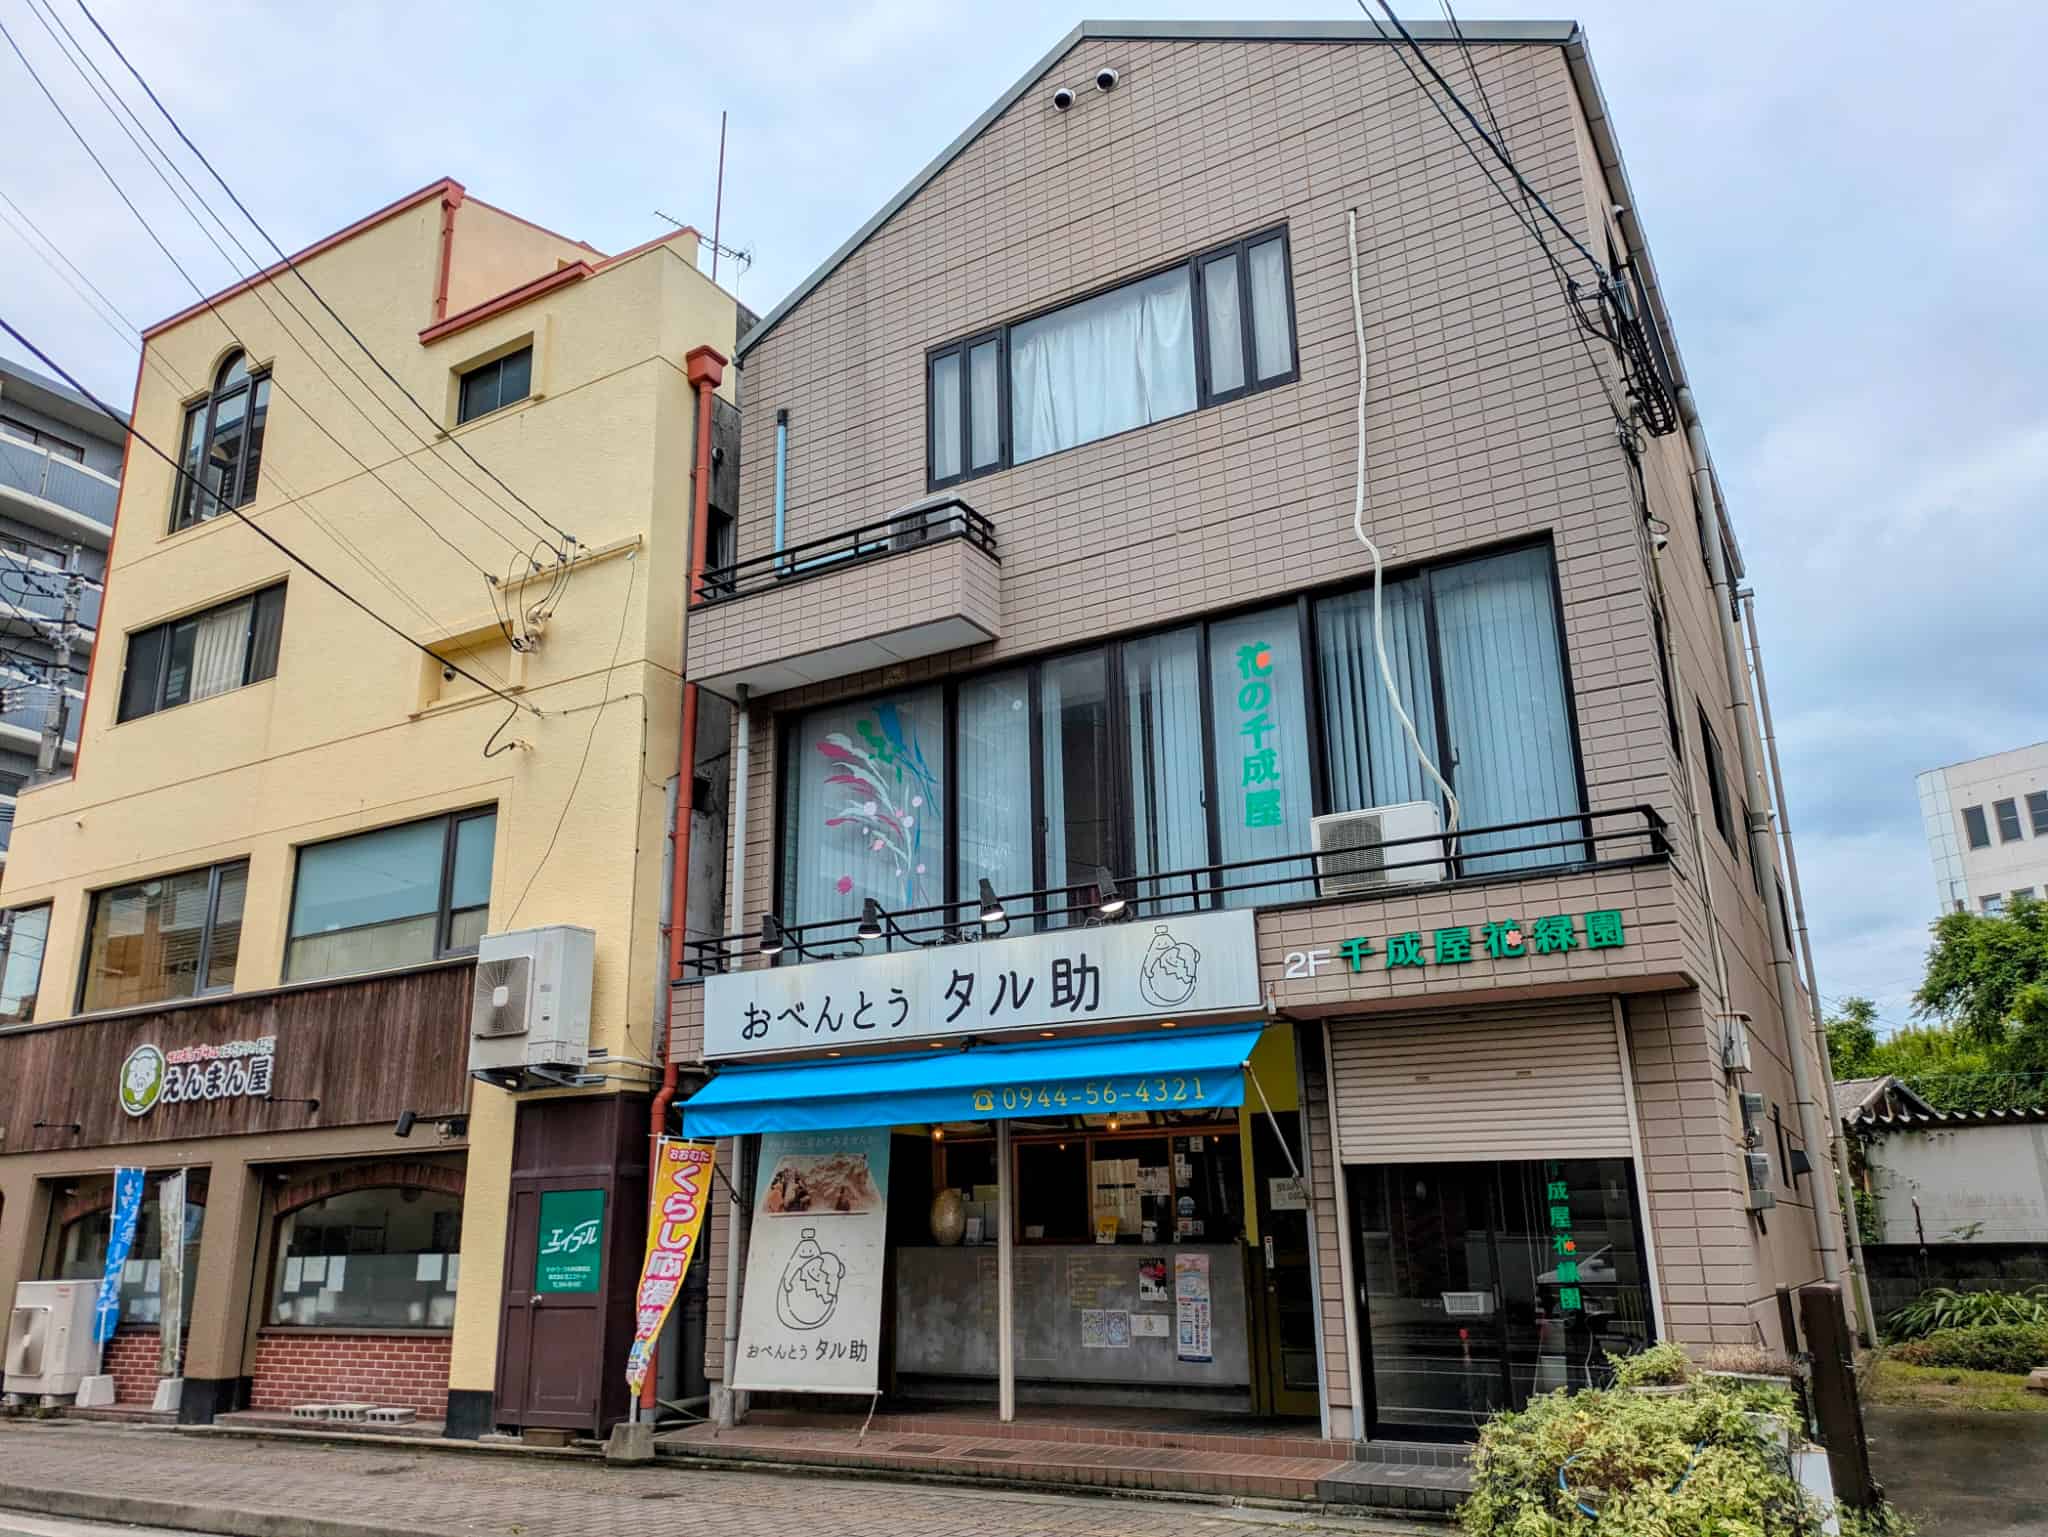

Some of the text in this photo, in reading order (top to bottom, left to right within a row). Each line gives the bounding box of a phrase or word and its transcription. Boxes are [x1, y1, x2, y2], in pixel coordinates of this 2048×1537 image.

[1236, 640, 1282, 829] 花の千成屋
[1283, 910, 1625, 978] 2F 千成屋花緑園
[741, 952, 1101, 1040] おべんとう タル助
[161, 1055, 273, 1103] えんまん屋
[1002, 1076, 1205, 1110] 0944-56-4321
[669, 1147, 711, 1164] おおむた
[541, 1219, 600, 1255] エイブル
[746, 1337, 869, 1363] おべんとう タル助
